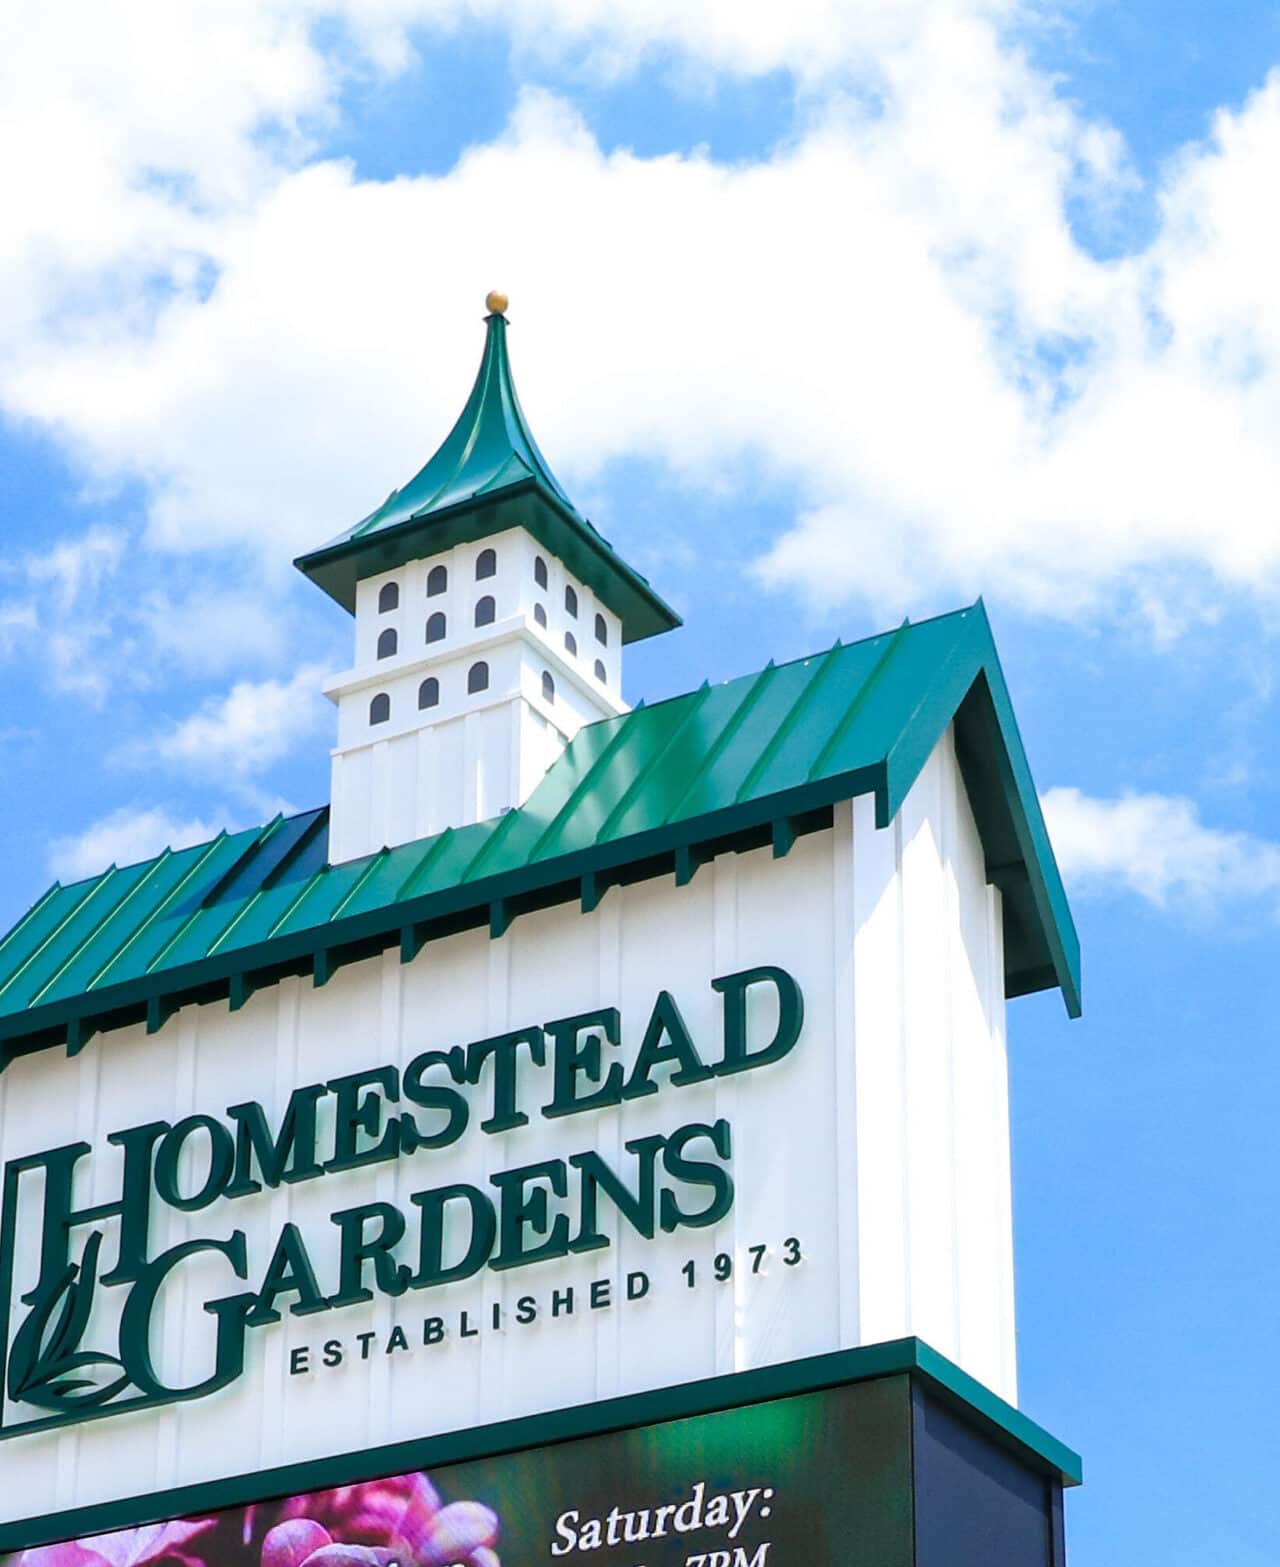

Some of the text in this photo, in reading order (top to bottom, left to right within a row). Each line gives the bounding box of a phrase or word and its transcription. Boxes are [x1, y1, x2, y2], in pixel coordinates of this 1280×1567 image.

[16, 965, 805, 1305] HOMESTEAD
[120, 1118, 734, 1402] GARDENS
[289, 1236, 804, 1375] ESTABLISHED 1973
[551, 1482, 774, 1556] Saturday:
